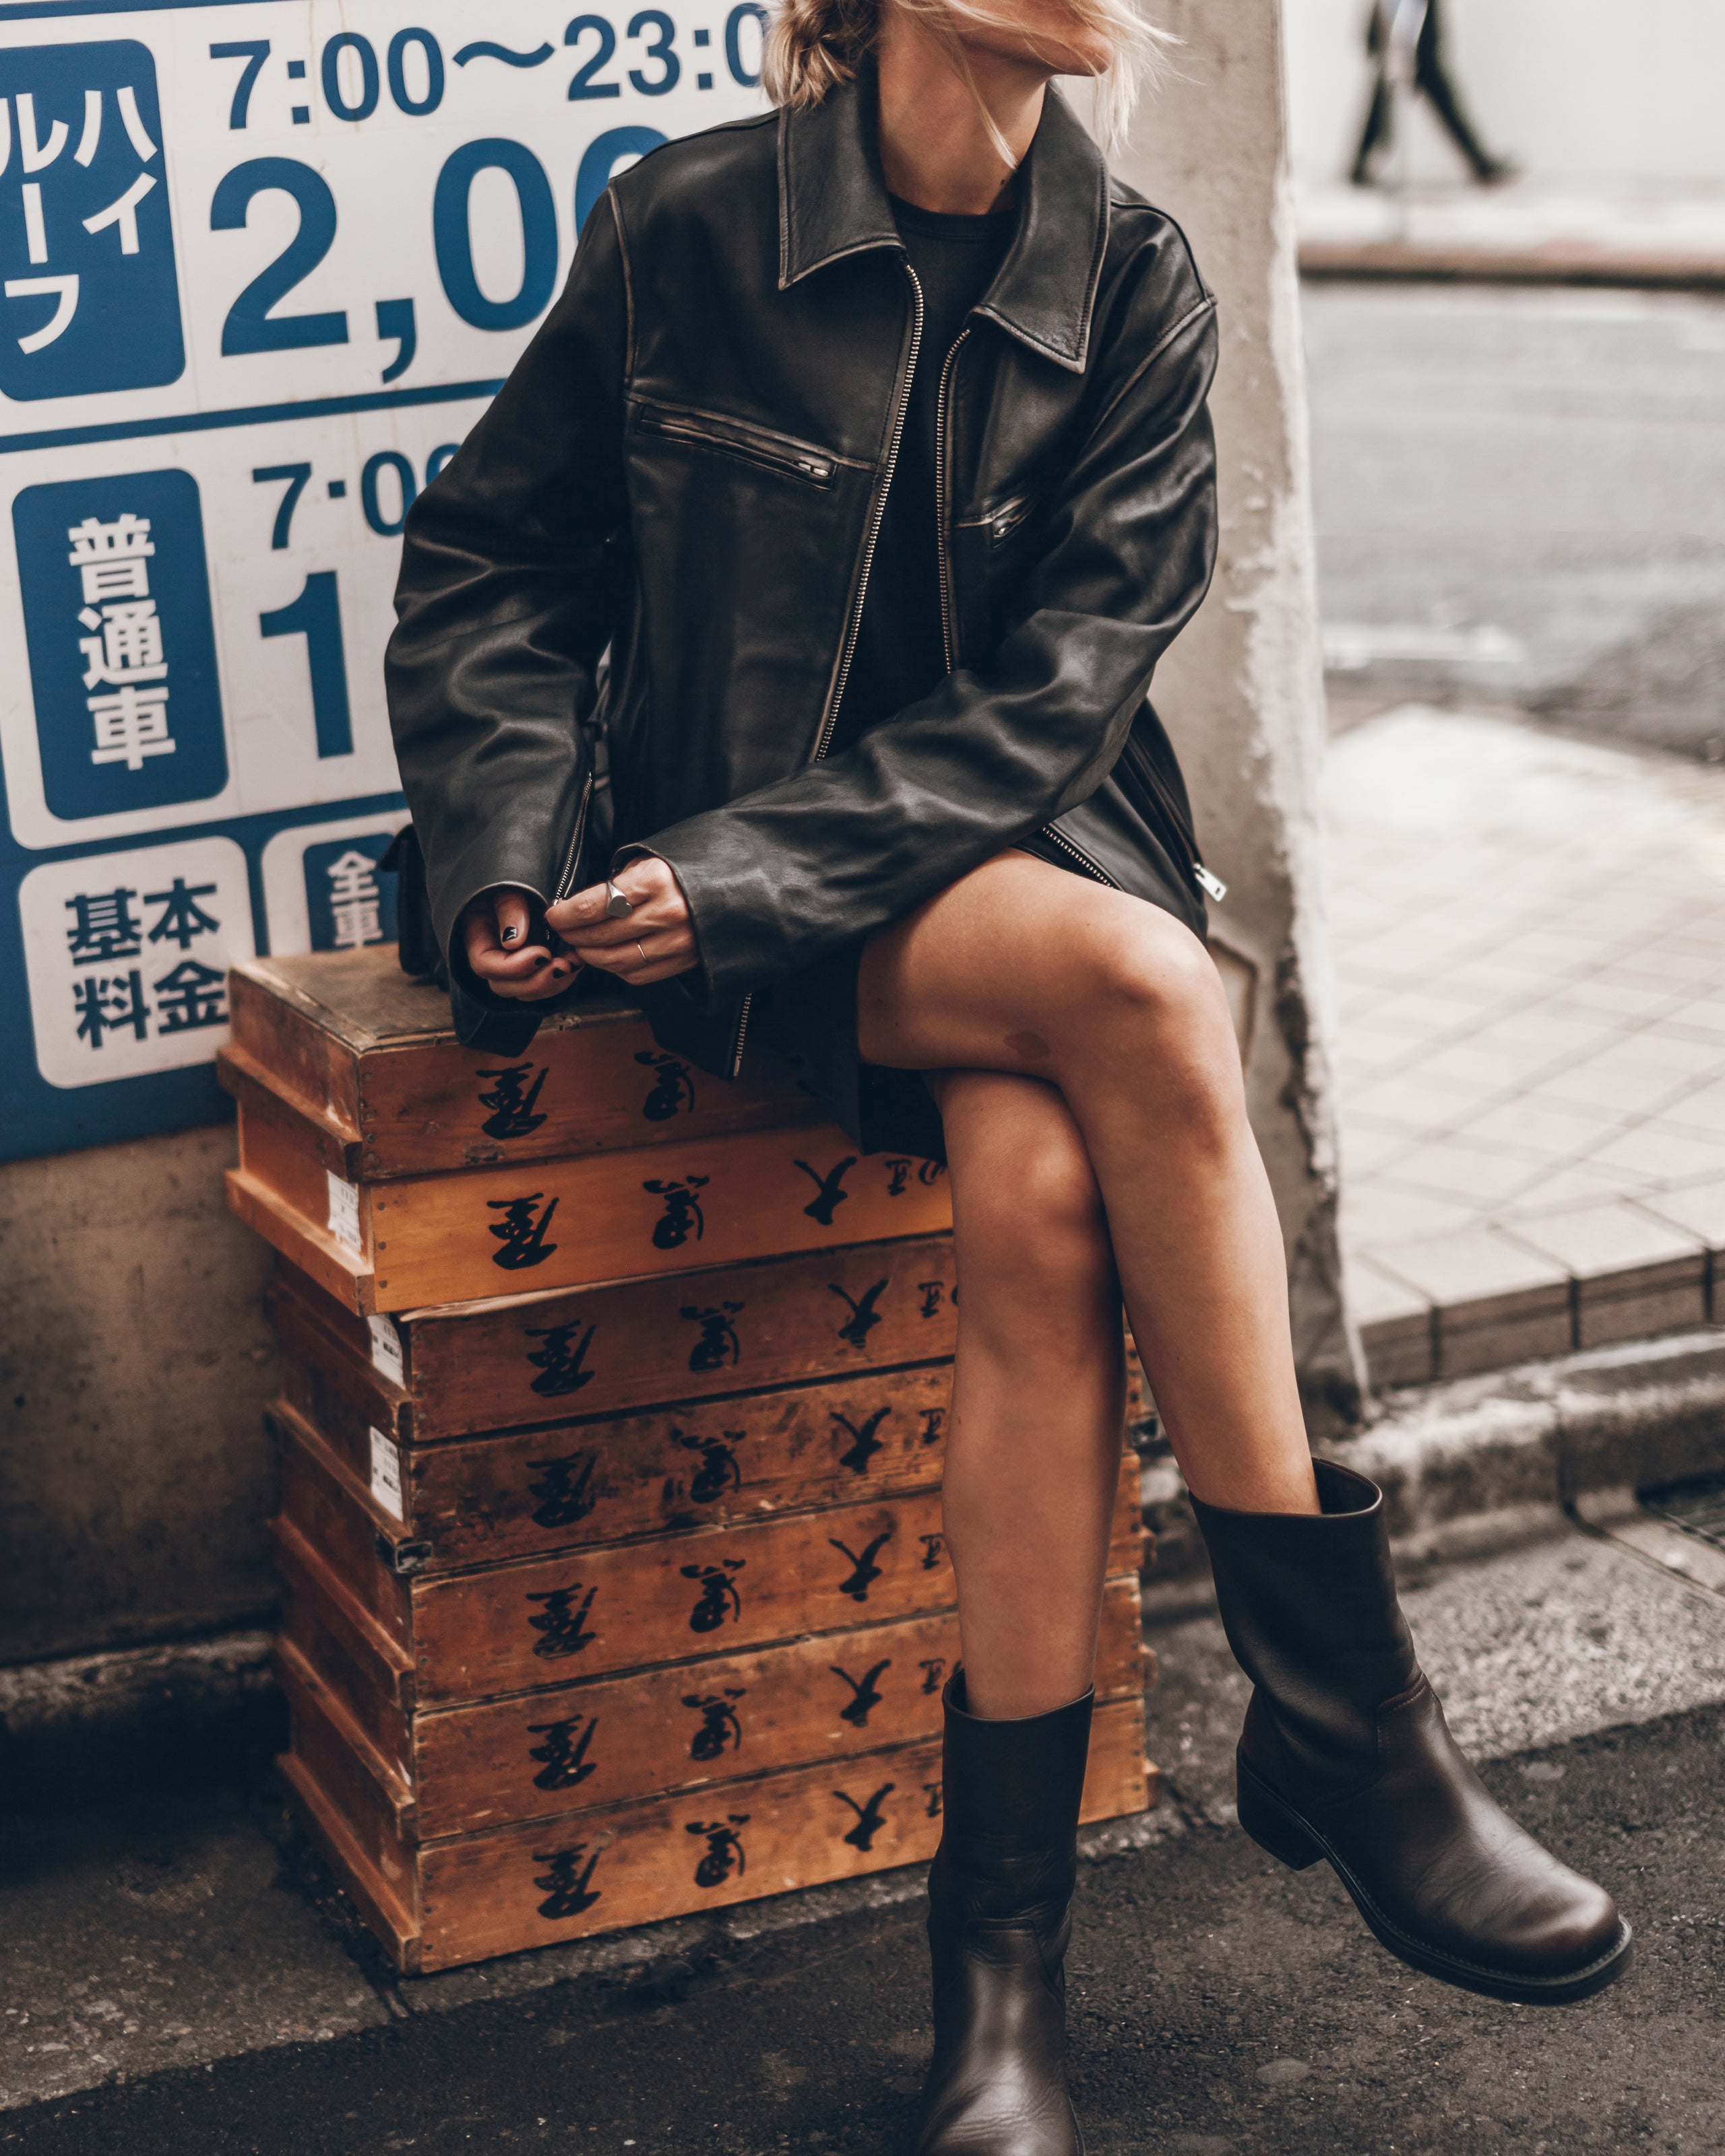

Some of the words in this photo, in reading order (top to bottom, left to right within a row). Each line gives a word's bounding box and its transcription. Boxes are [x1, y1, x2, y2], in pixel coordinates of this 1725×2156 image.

[73, 86, 158, 255] ハイ
[68, 513, 176, 770] 普通車
[259, 569, 354, 760] 1
[65, 877, 221, 966] 基本
[72, 960, 230, 1052] 料金
